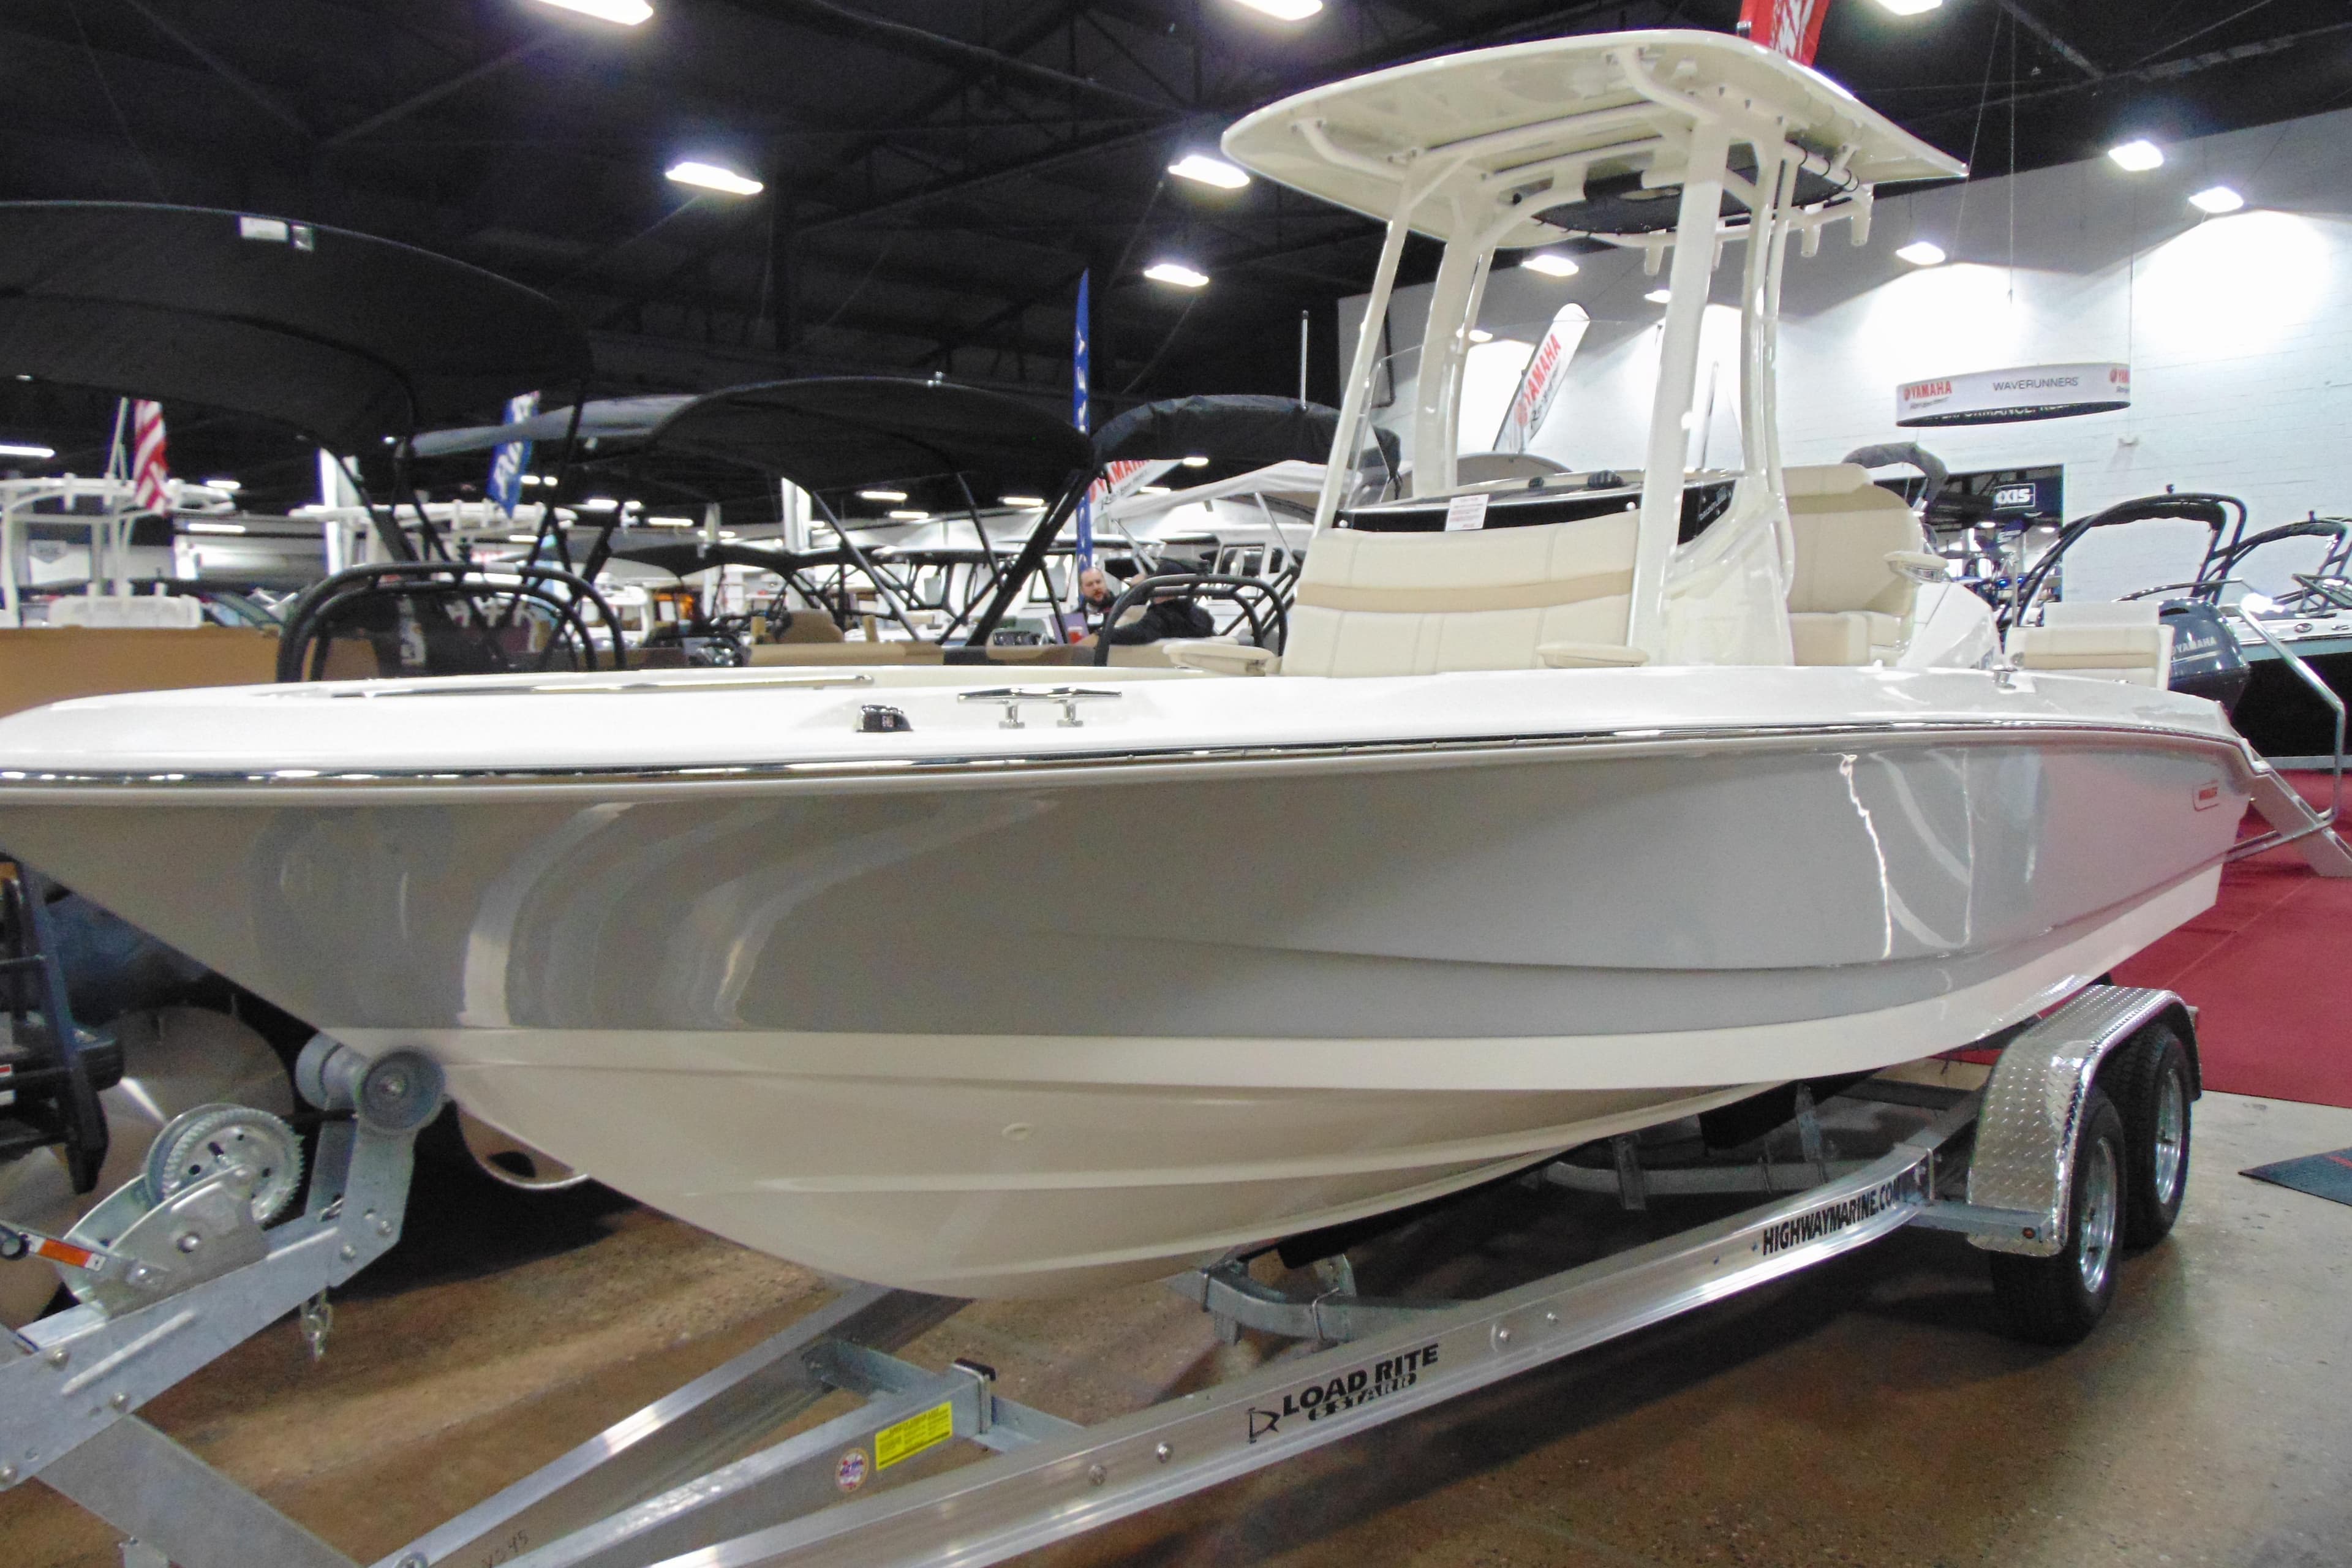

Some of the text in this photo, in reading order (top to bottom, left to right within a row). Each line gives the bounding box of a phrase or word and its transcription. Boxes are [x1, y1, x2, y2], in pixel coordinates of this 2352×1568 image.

[1523, 333, 1562, 407] YAMAHA
[1910, 380, 1953, 399] YAMAHA
[1992, 376, 2080, 392] WAVERUNNERS
[2175, 636, 2217, 654] YAMAHA
[1763, 1176, 1901, 1256] HIGHWAYMARINE.COM
[1283, 1342, 1439, 1417] LOAD RITE
